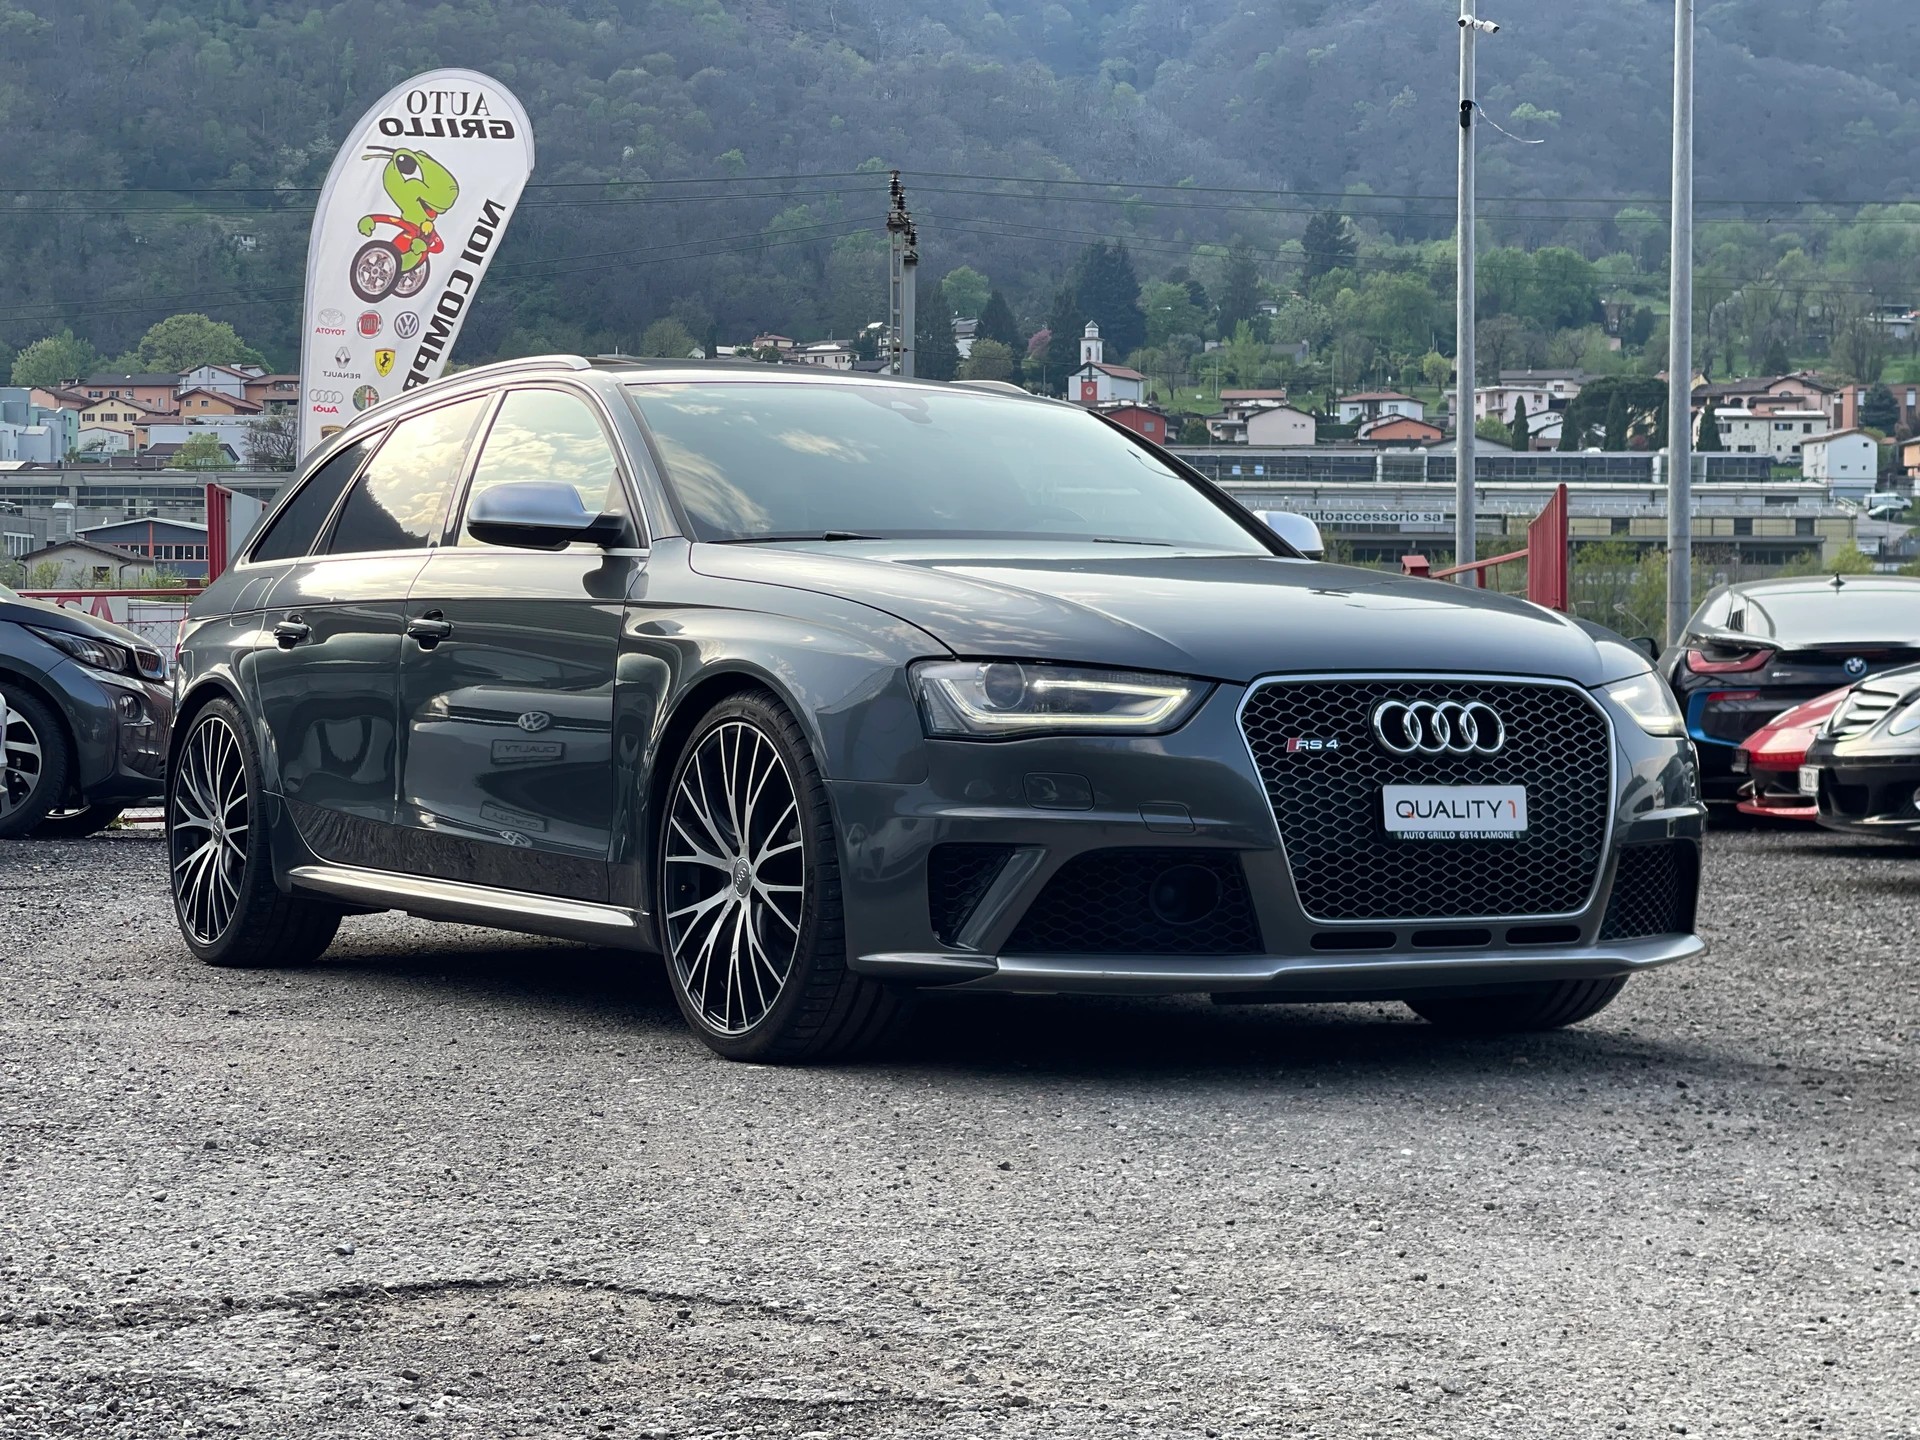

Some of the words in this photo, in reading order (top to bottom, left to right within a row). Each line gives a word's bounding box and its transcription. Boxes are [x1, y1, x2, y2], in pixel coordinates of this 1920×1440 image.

[1423, 513, 1441, 522] sa
[1295, 739, 1323, 750] RS
[1325, 739, 1339, 749] 4
[1395, 800, 1502, 819] QUALITY
[1403, 831, 1425, 840] AUTO
[1427, 831, 1456, 840] GRILLO
[1459, 831, 1479, 840] 6814
[1480, 831, 1515, 840] LAMONE
